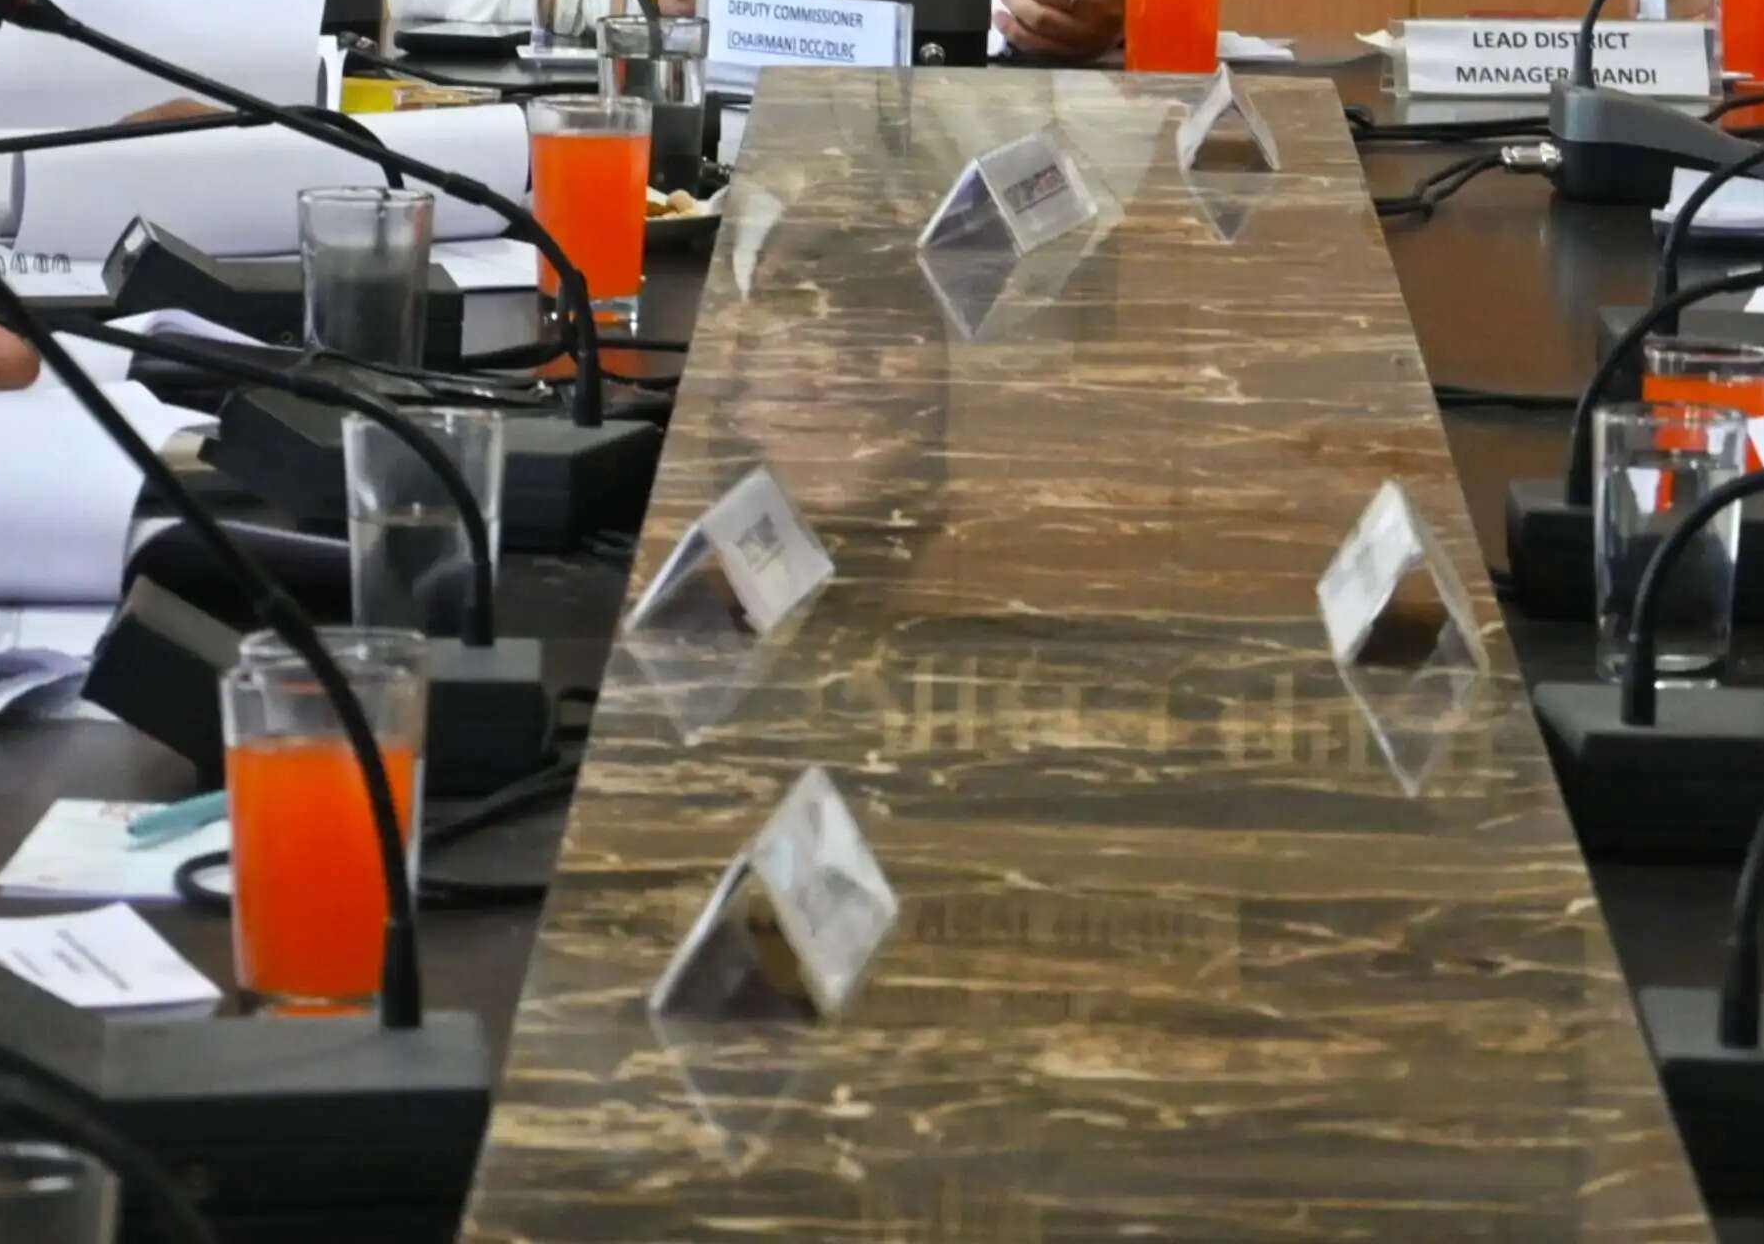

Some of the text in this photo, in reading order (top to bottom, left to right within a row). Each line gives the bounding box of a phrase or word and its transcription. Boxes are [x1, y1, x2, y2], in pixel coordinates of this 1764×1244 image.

[727, 0, 863, 29] DEPUTY COMMISSIONER
[799, 37, 856, 59] DCC/DLRC
[1472, 31, 1630, 50] LEAD DISTICT
[1455, 66, 1569, 85] MANAGER
